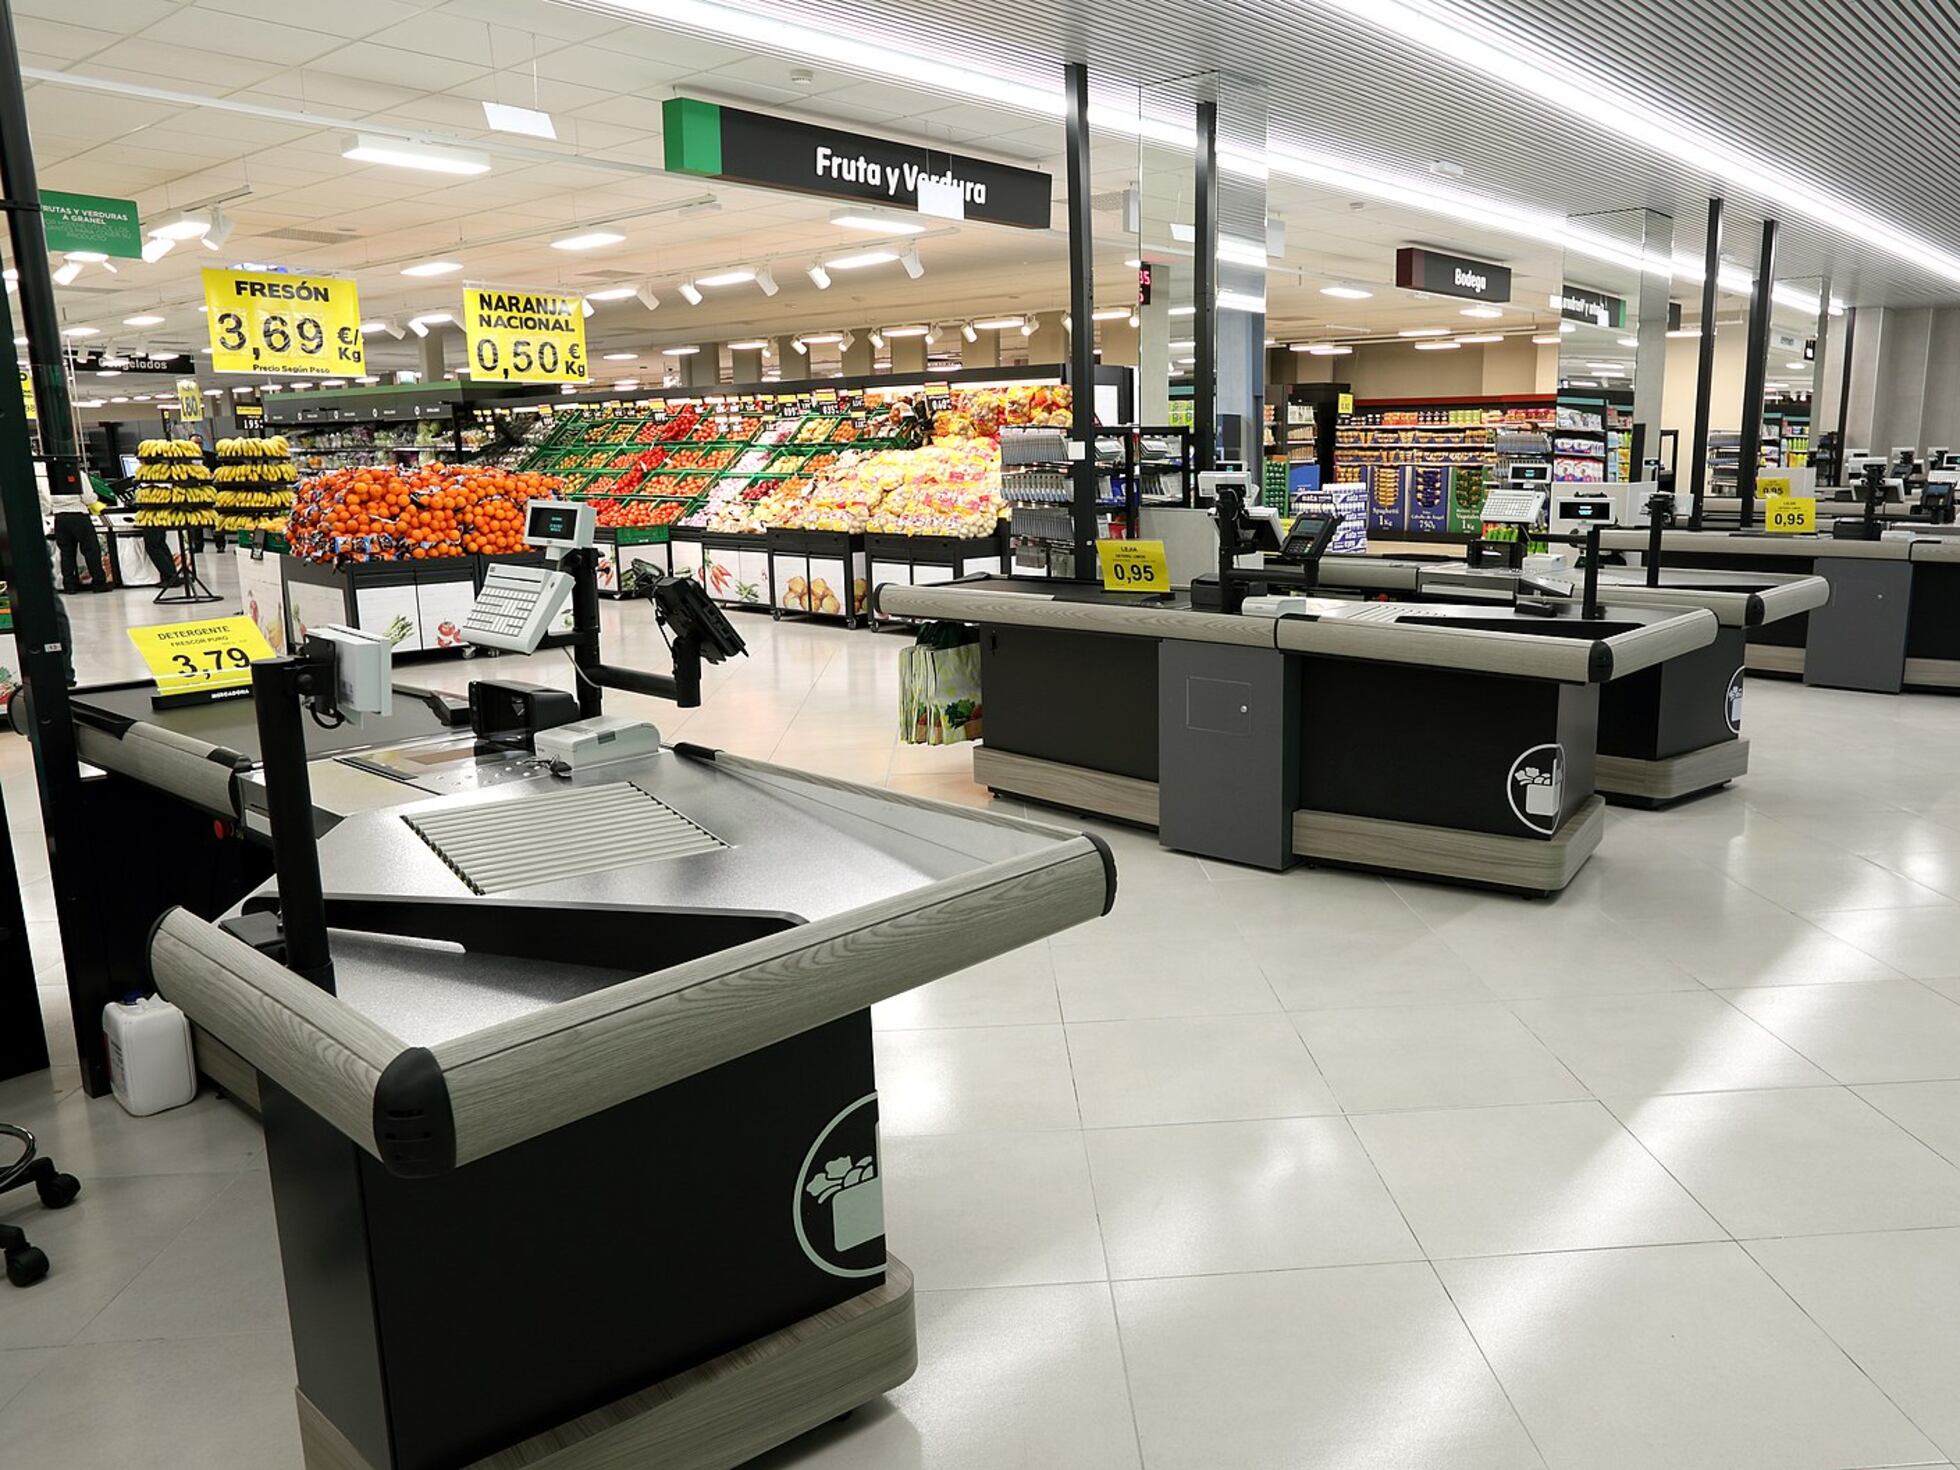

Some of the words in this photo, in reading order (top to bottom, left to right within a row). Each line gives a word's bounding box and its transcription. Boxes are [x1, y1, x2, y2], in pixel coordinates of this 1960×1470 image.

[816, 146, 881, 186] Fruta
[886, 166, 899, 196] y
[71, 214, 106, 225] GRANEL
[74, 208, 79, 216] Y
[81, 209, 128, 221] VERDURAS
[1455, 267, 1487, 293] Bodega
[235, 280, 330, 302] FRESÓN
[479, 293, 571, 316] NARANJA
[479, 314, 575, 333] NACIONAL
[218, 313, 324, 361] 3,69
[338, 346, 361, 363] Kg
[477, 338, 559, 380] 0,50
[569, 343, 581, 359] €
[253, 363, 281, 373] Precio
[281, 364, 308, 374] Según
[309, 366, 330, 374] Peso
[565, 361, 586, 377] Kg
[1774, 513, 1805, 527] 0,95
[1113, 563, 1155, 584] 0,95
[157, 625, 230, 641] DETERGENTE
[172, 647, 250, 680] 3,79
